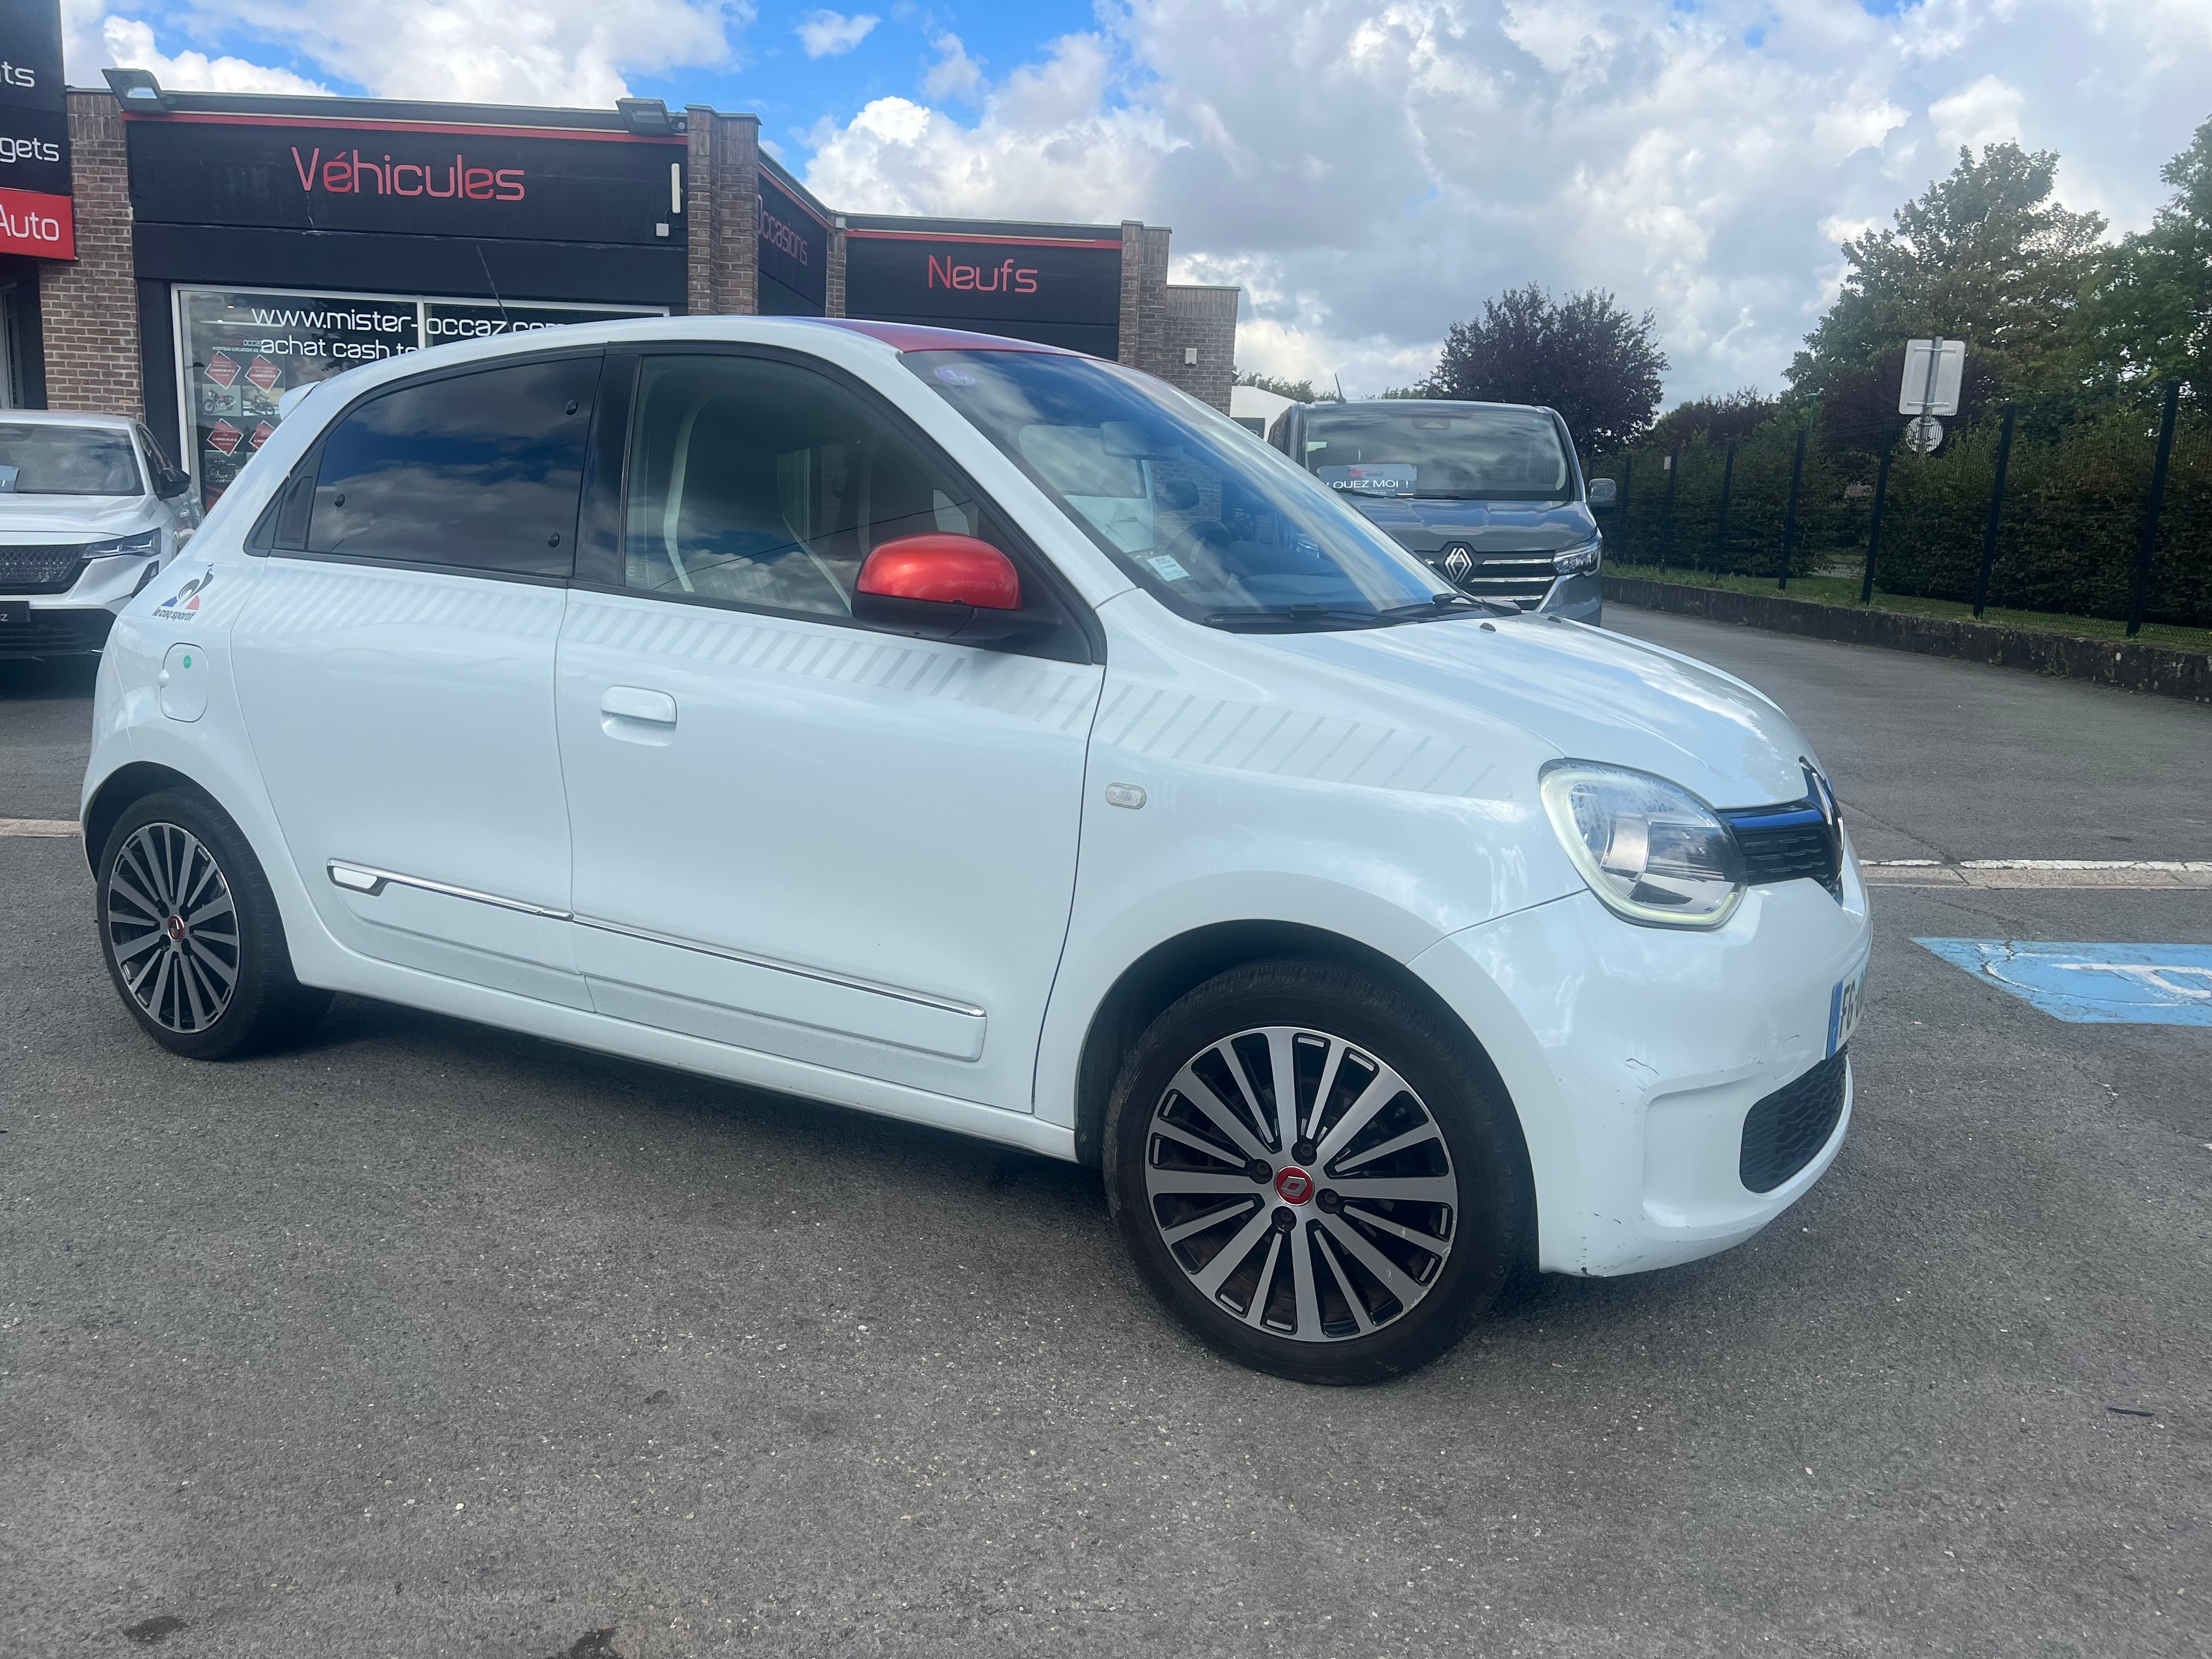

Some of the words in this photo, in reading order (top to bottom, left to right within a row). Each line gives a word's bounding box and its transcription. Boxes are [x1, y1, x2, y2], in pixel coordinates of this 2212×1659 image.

[0, 61, 35, 87] ts
[291, 146, 525, 201] Véhicules
[929, 255, 1037, 292] Neufs
[261, 335, 327, 356] achat
[333, 339, 390, 359] cash
[1373, 480, 1399, 488] MOI
[170, 611, 197, 621] sportif
